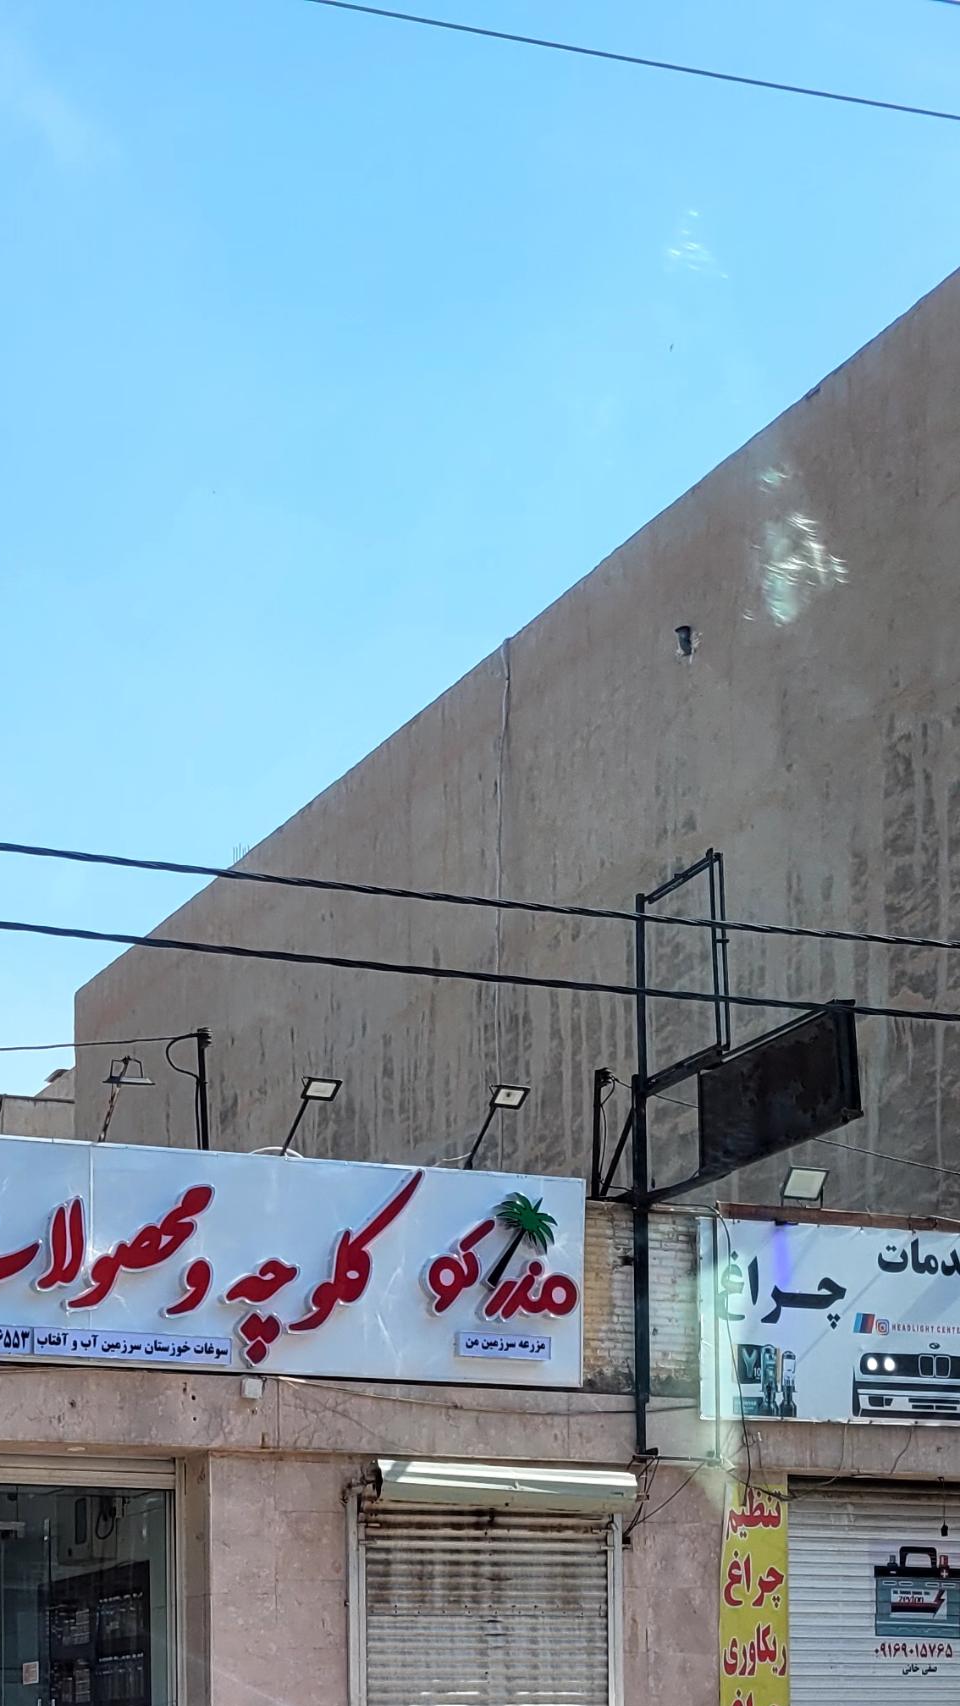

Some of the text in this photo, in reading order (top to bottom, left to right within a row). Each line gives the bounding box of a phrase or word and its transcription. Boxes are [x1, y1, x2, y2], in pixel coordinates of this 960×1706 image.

[877, 1237, 960, 1277] دمات
[226, 1170, 424, 1364] کلوچه
[165, 1257, 211, 1316] و
[713, 1250, 847, 1330] چراغ
[891, 1323, 934, 1333] HEADLIGHT
[37, 1332, 69, 1347] آفتاب
[81, 1335, 99, 1349] آب
[101, 1336, 142, 1354] سرزمین
[144, 1338, 190, 1356] خوزستان
[194, 1338, 228, 1359] سوغات
[465, 1337, 546, 1353] مزرعه سرزمین من
[724, 1550, 785, 1608] چراغ
[723, 1622, 787, 1676] ریکاوری
[874, 1642, 953, 1658] ۰۹۱۶۹۰۱۵۷۶۵
